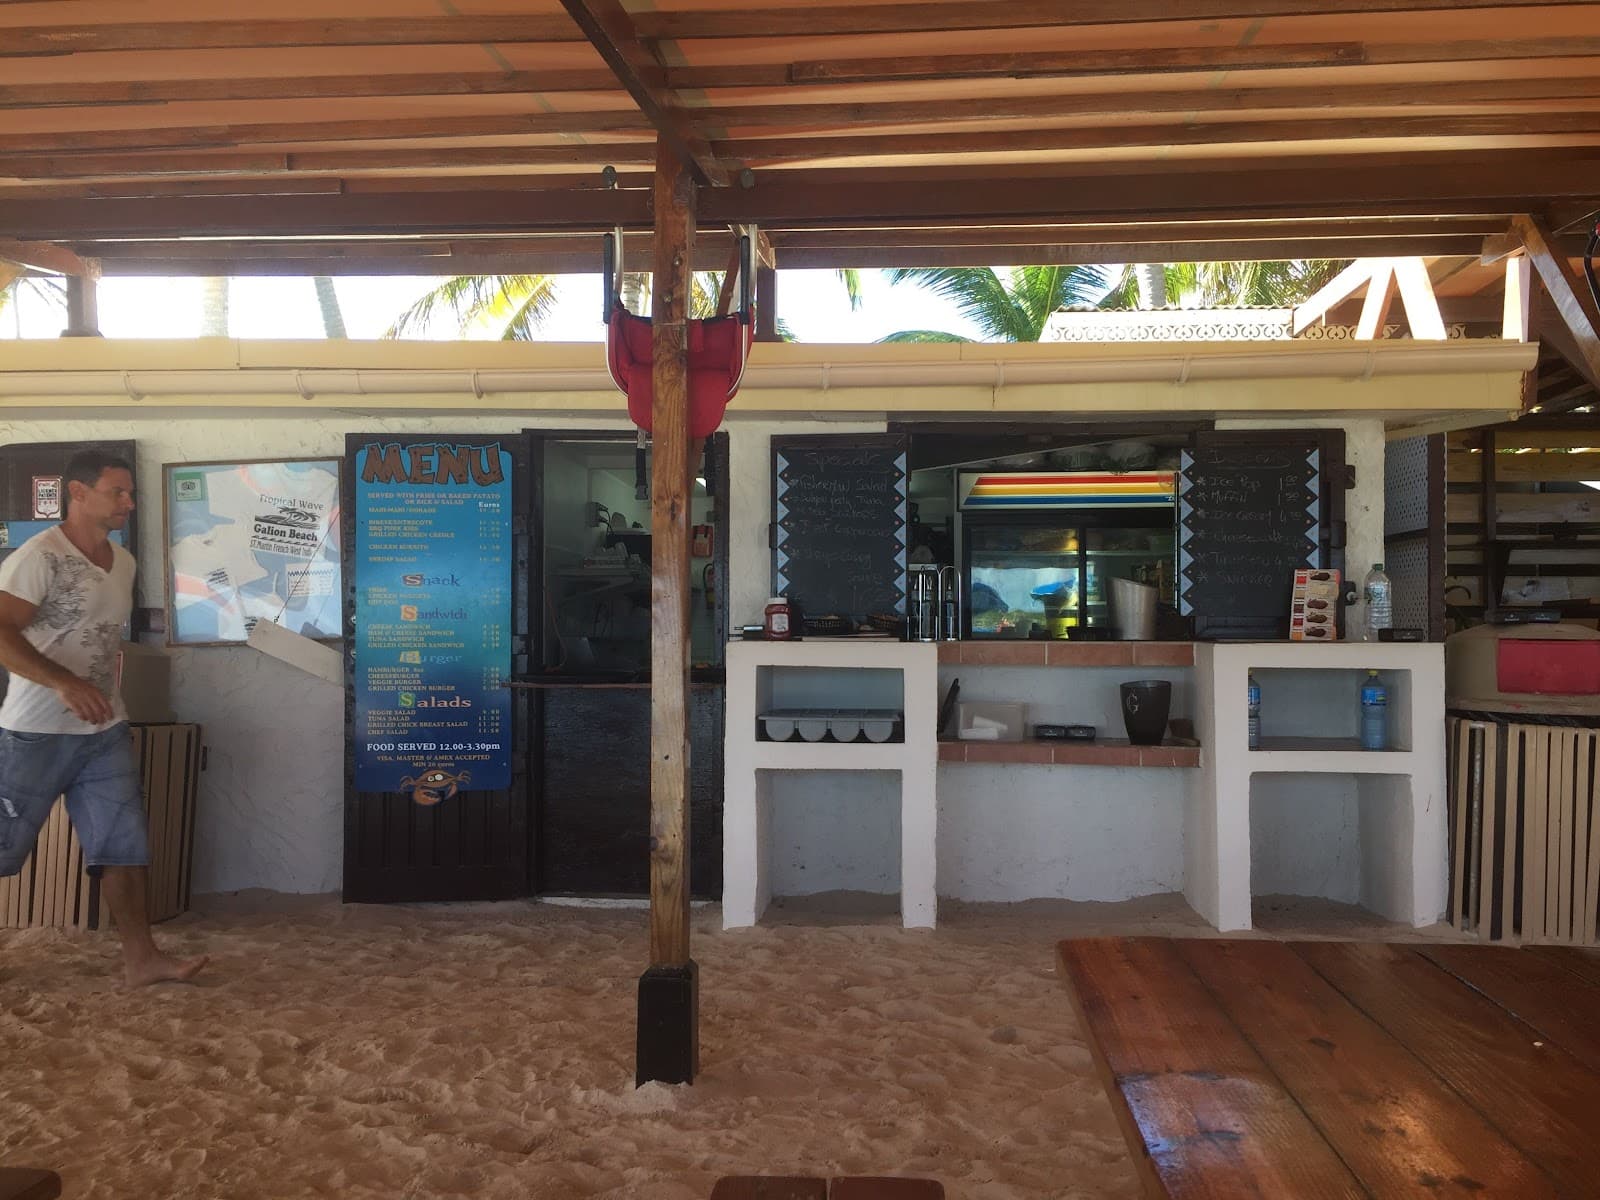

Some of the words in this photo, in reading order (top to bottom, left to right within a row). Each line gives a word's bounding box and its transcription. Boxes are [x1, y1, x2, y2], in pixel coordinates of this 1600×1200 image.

[361, 442, 504, 487] MENU
[259, 494, 296, 508] Tropical
[300, 500, 324, 510] Wave
[254, 524, 286, 538] Galion
[288, 529, 318, 542] Beach
[402, 573, 461, 588] Snack
[400, 604, 468, 621] Sandwich
[400, 650, 462, 664] Burger
[398, 692, 472, 708] Salads
